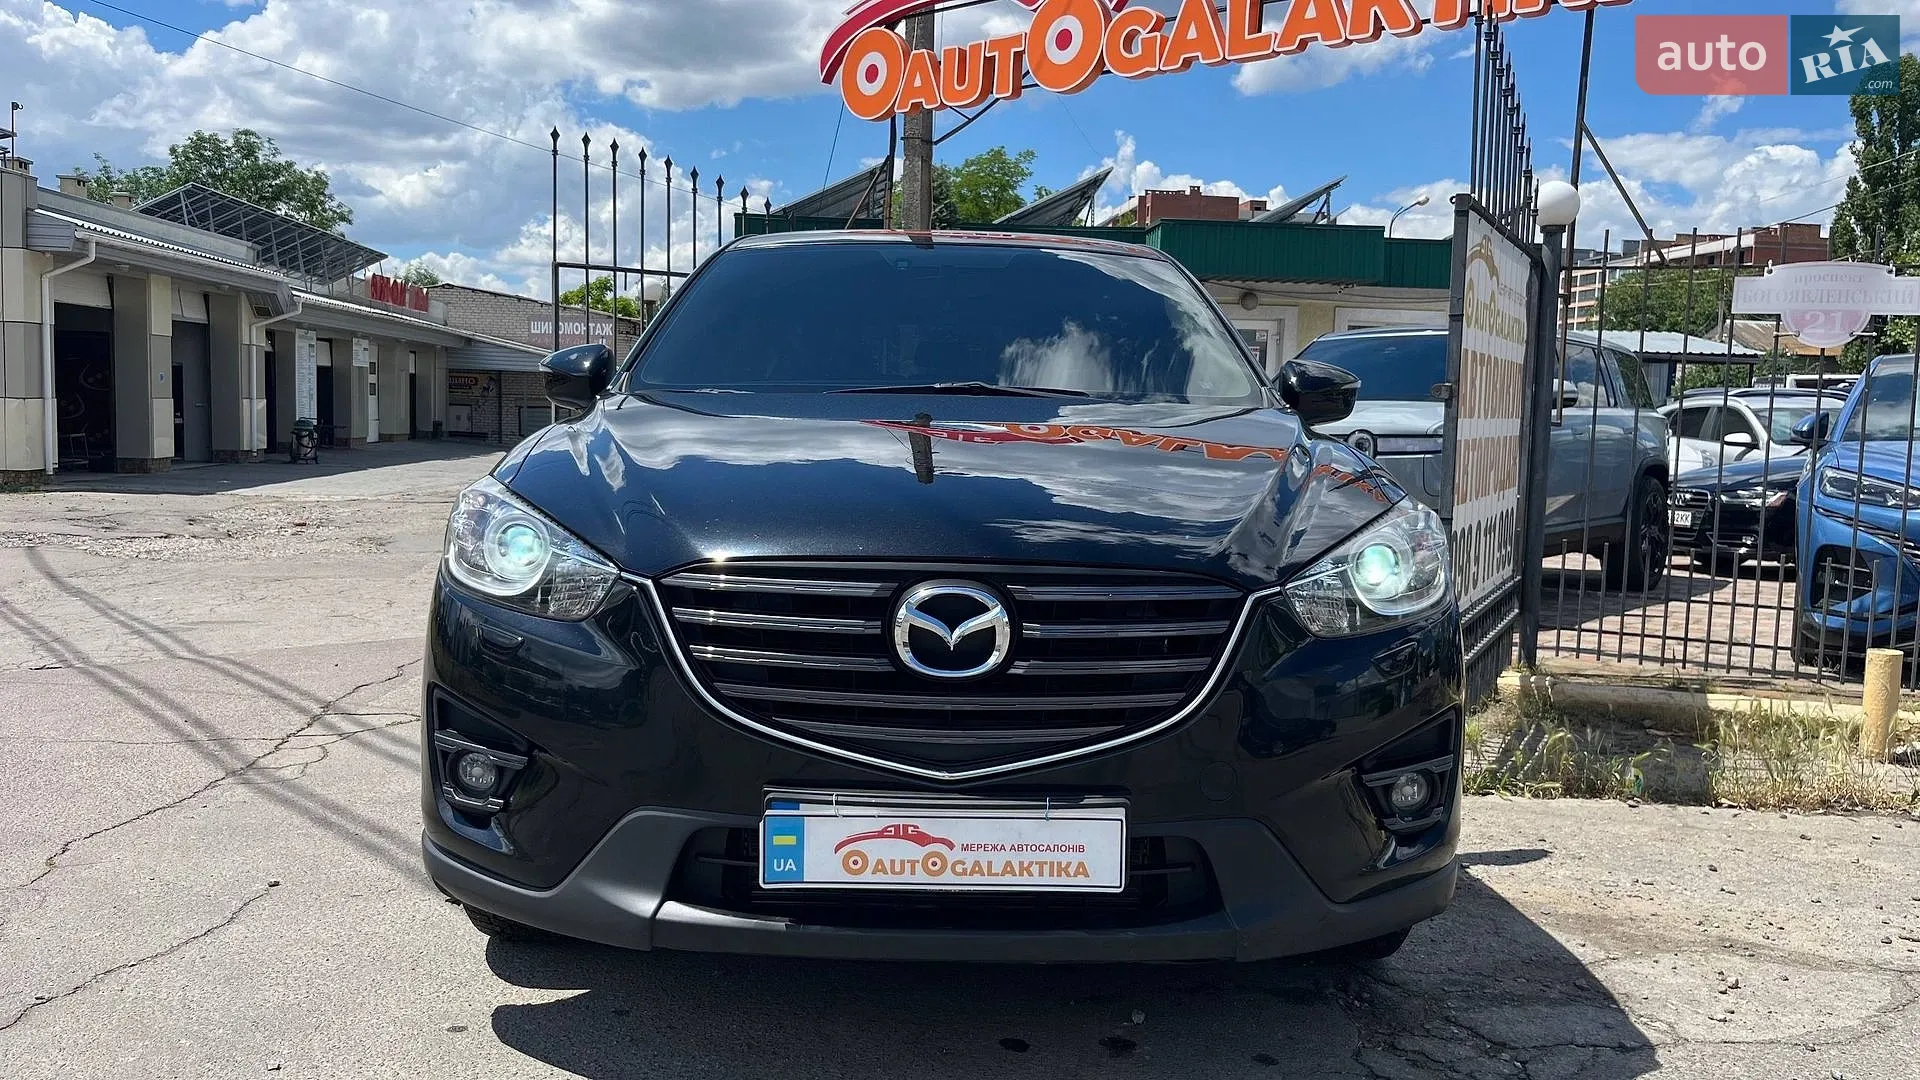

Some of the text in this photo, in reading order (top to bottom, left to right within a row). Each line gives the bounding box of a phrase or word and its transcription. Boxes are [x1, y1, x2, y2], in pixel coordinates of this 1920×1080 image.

[1794, 272, 1864, 286] проспект
[1804, 311, 1843, 334] 21
[960, 842, 1086, 854] МЕРЕЖА АВТОСАЛОНІВ
[773, 858, 797, 873] UA
